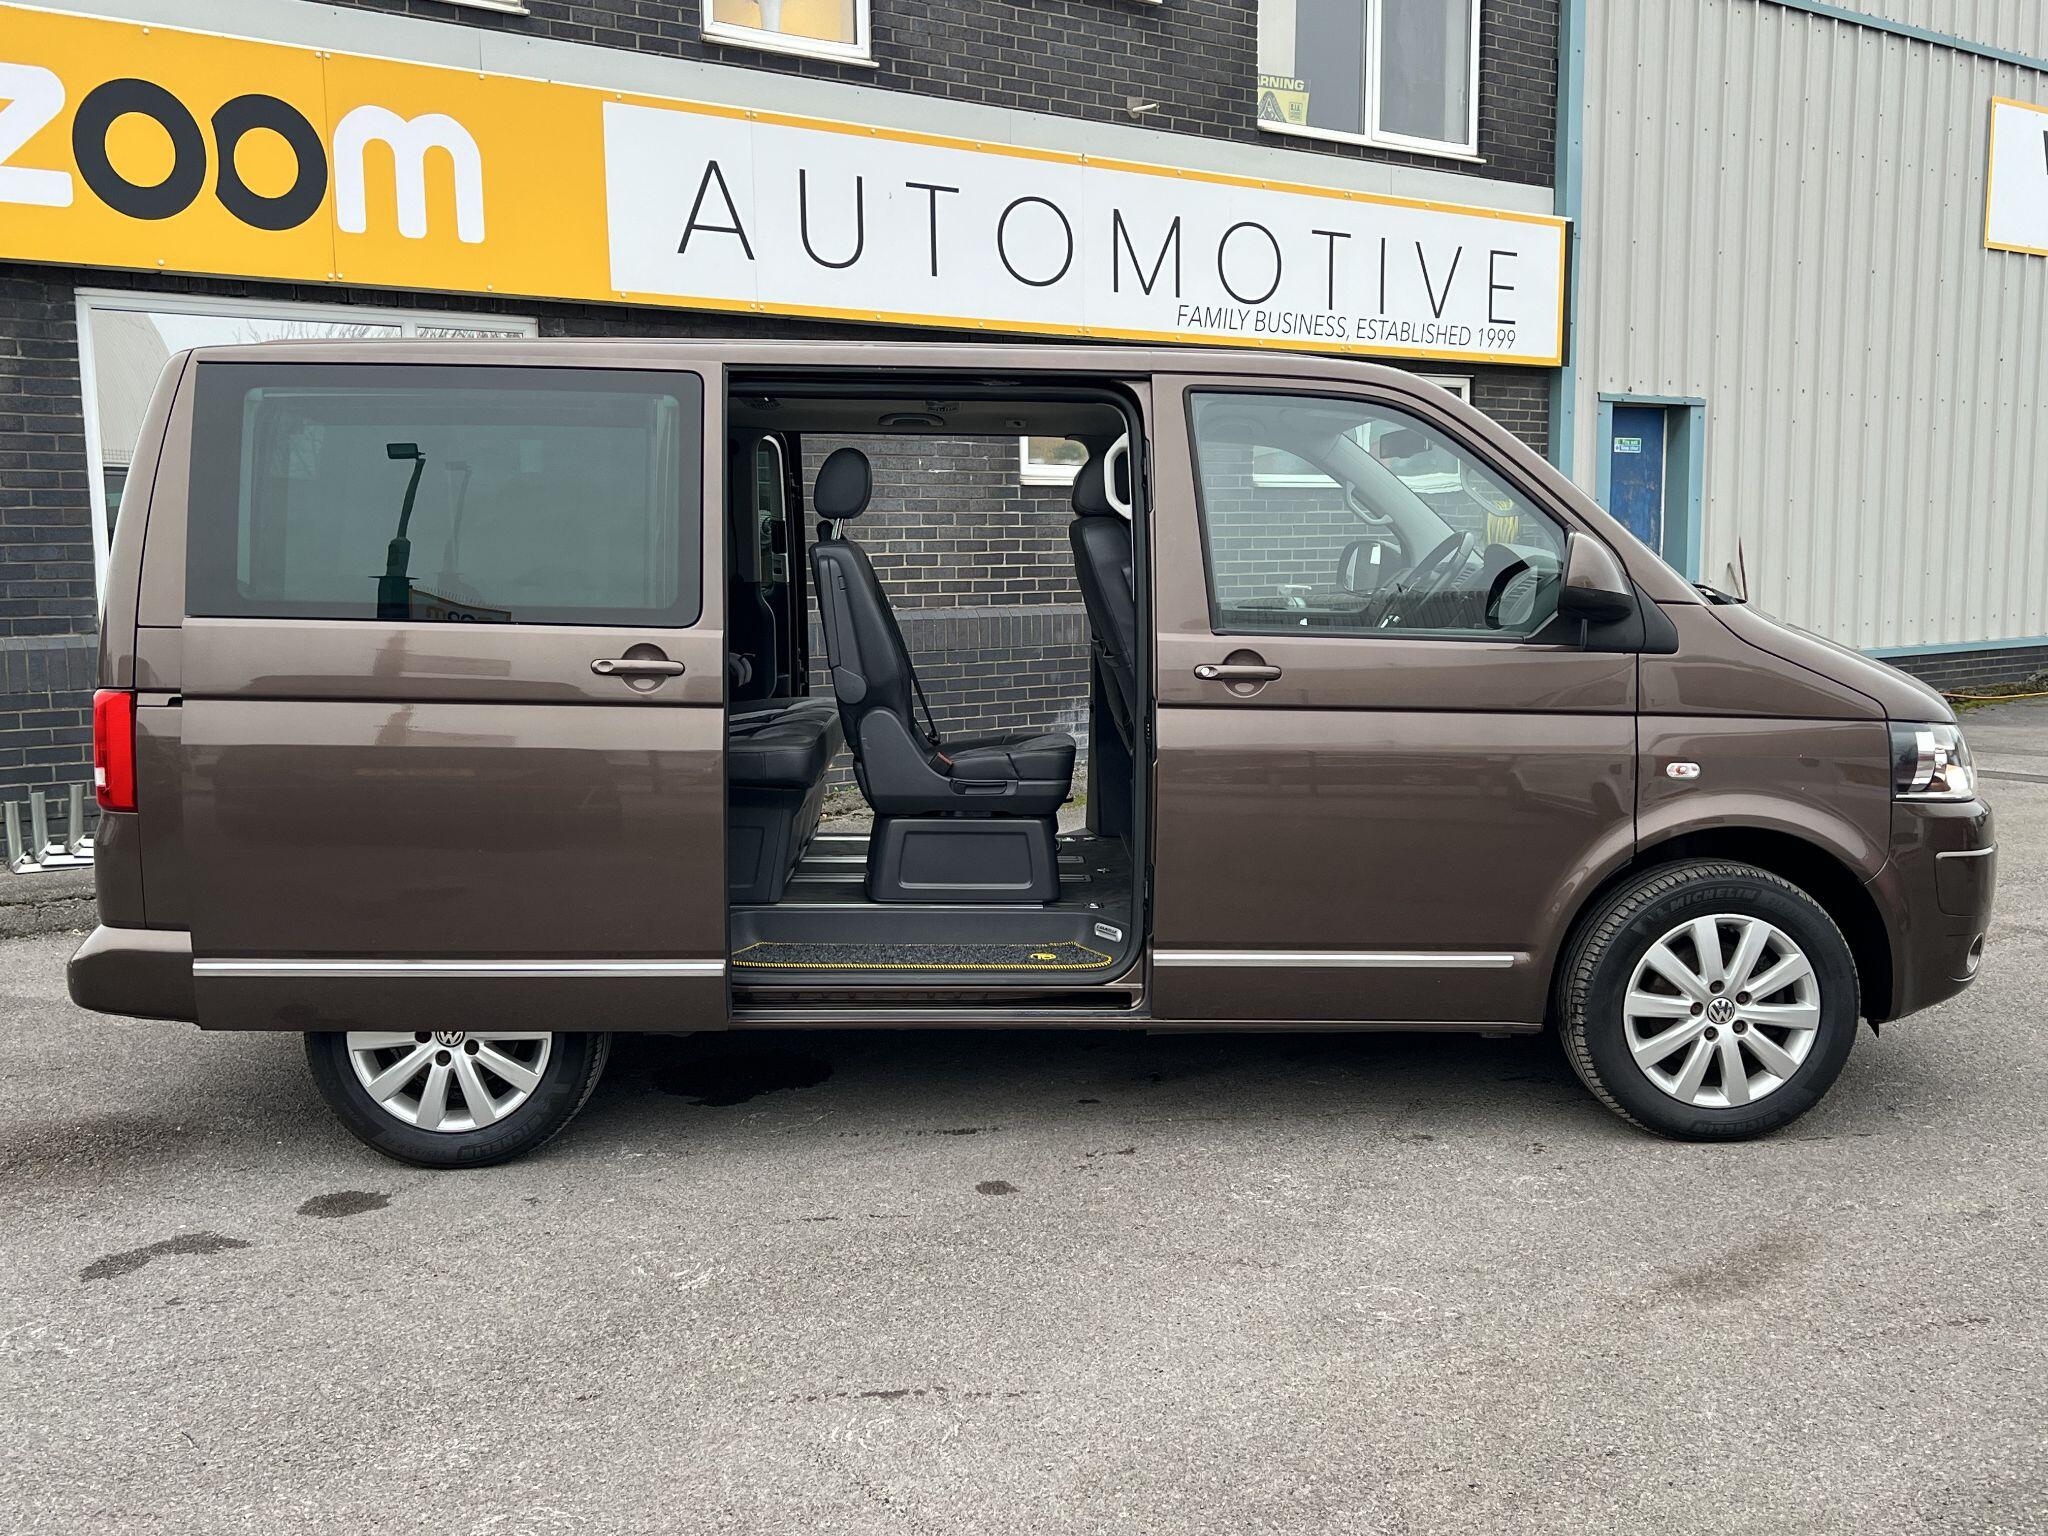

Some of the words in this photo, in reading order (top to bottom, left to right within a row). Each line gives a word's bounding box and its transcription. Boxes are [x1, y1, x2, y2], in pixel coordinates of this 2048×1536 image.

[1258, 75, 1305, 91] RNING
[677, 159, 1518, 325] AUTOMOTIVE
[1177, 304, 1251, 331] FAMILY
[1254, 310, 1350, 342] BUSINESS,
[1356, 318, 1472, 346] ESTABLISHED
[1478, 327, 1516, 349] 1999
[1669, 887, 1758, 912] MICHELIN
